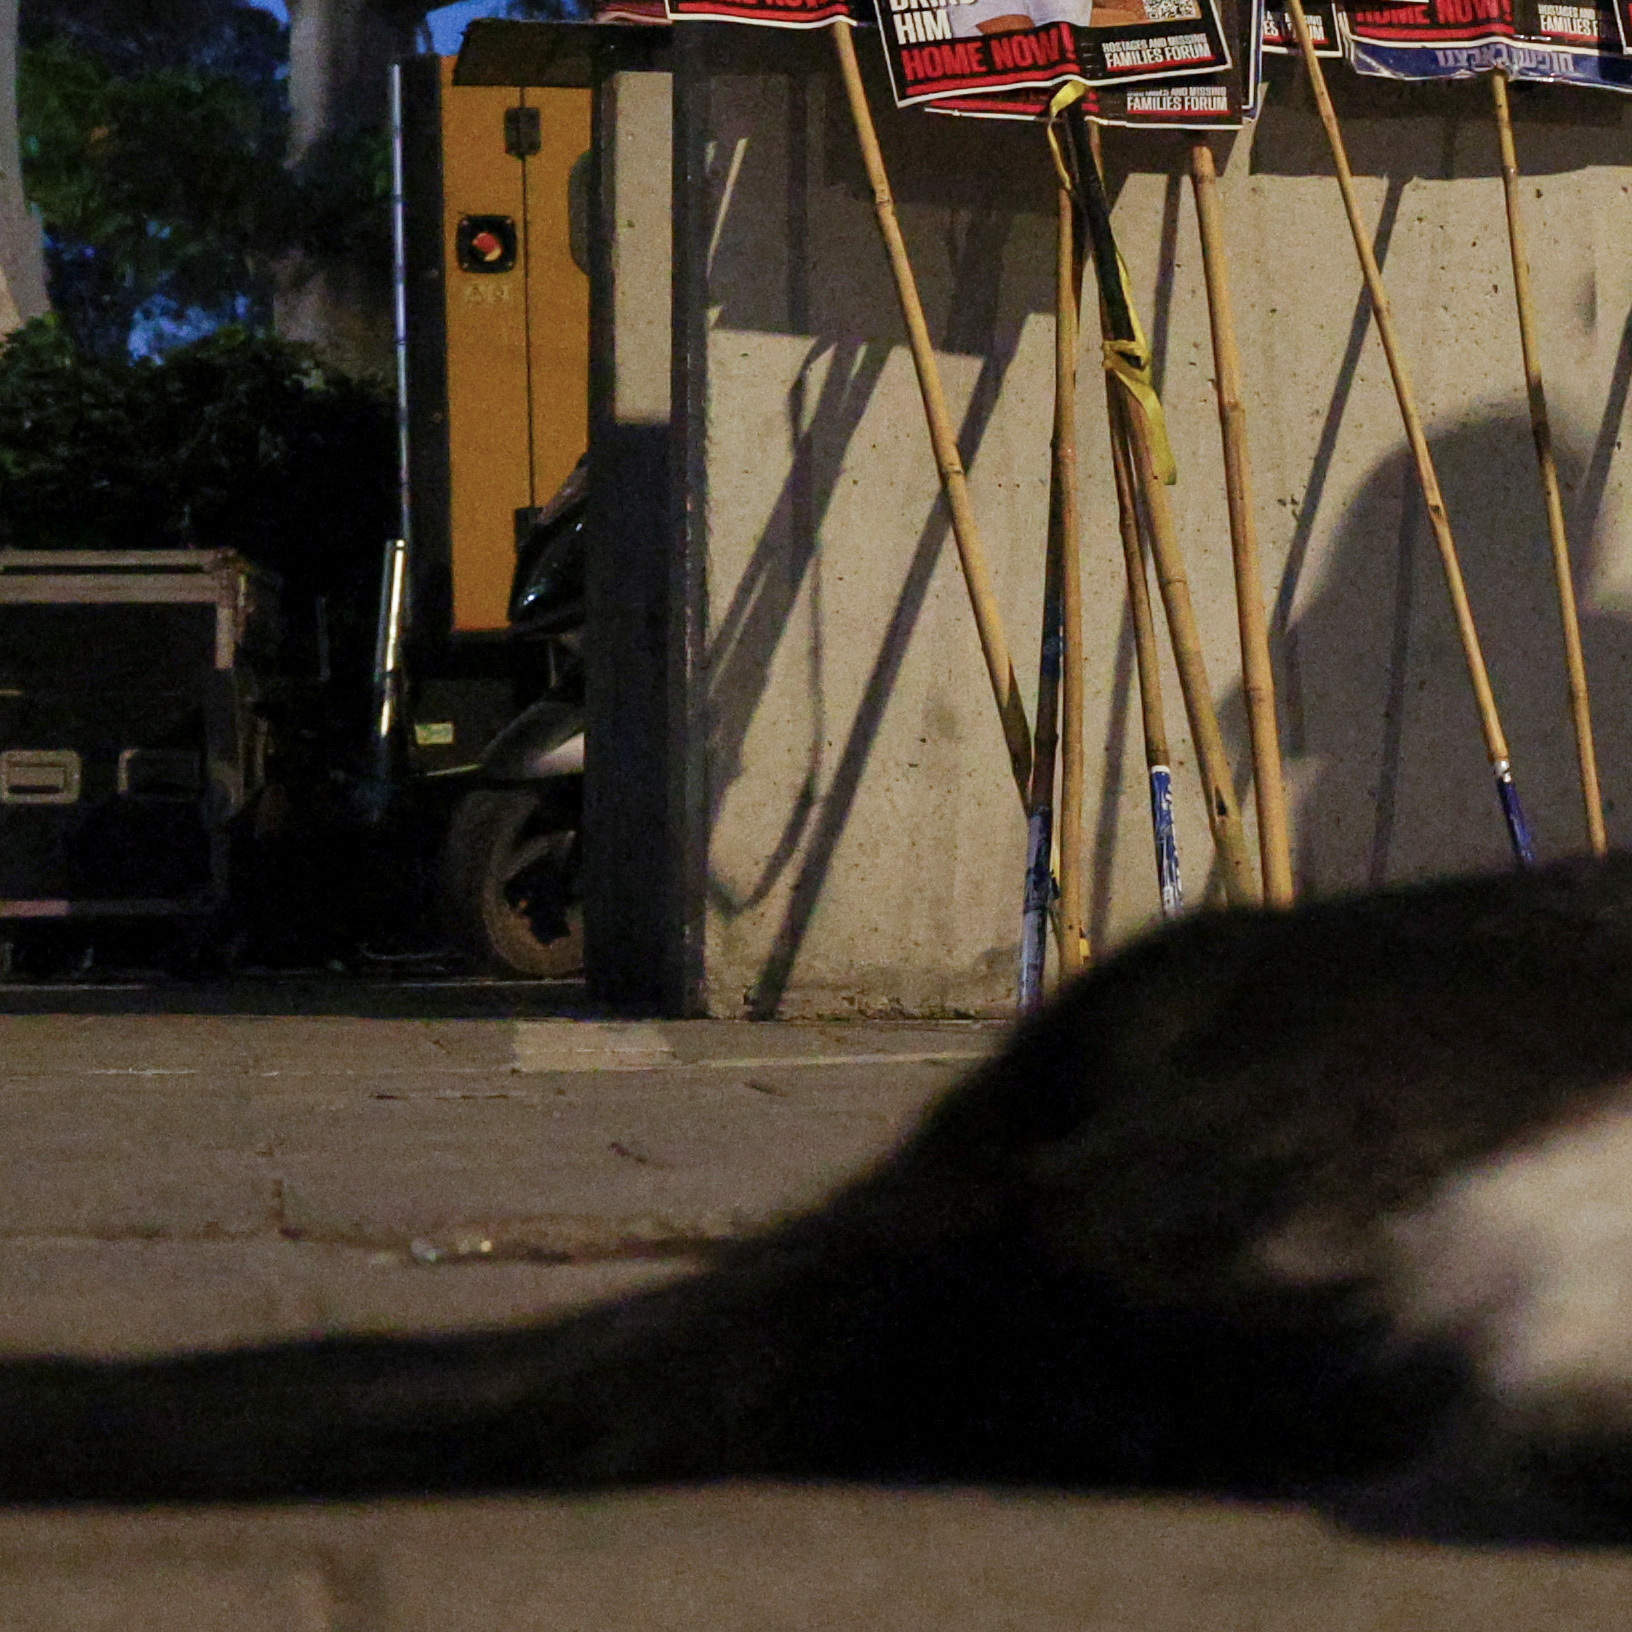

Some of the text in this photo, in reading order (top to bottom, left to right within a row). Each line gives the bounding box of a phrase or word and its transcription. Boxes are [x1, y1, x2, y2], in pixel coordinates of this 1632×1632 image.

[893, 9, 952, 45] HIM
[1540, 14, 1591, 36] FAMILIES
[901, 22, 1077, 81] HOME NOW!
[1102, 40, 1147, 53] HOSTAGES
[1105, 43, 1212, 68] FAMILIES FORUM
[1127, 96, 1228, 111] FAMILIES FORUM
